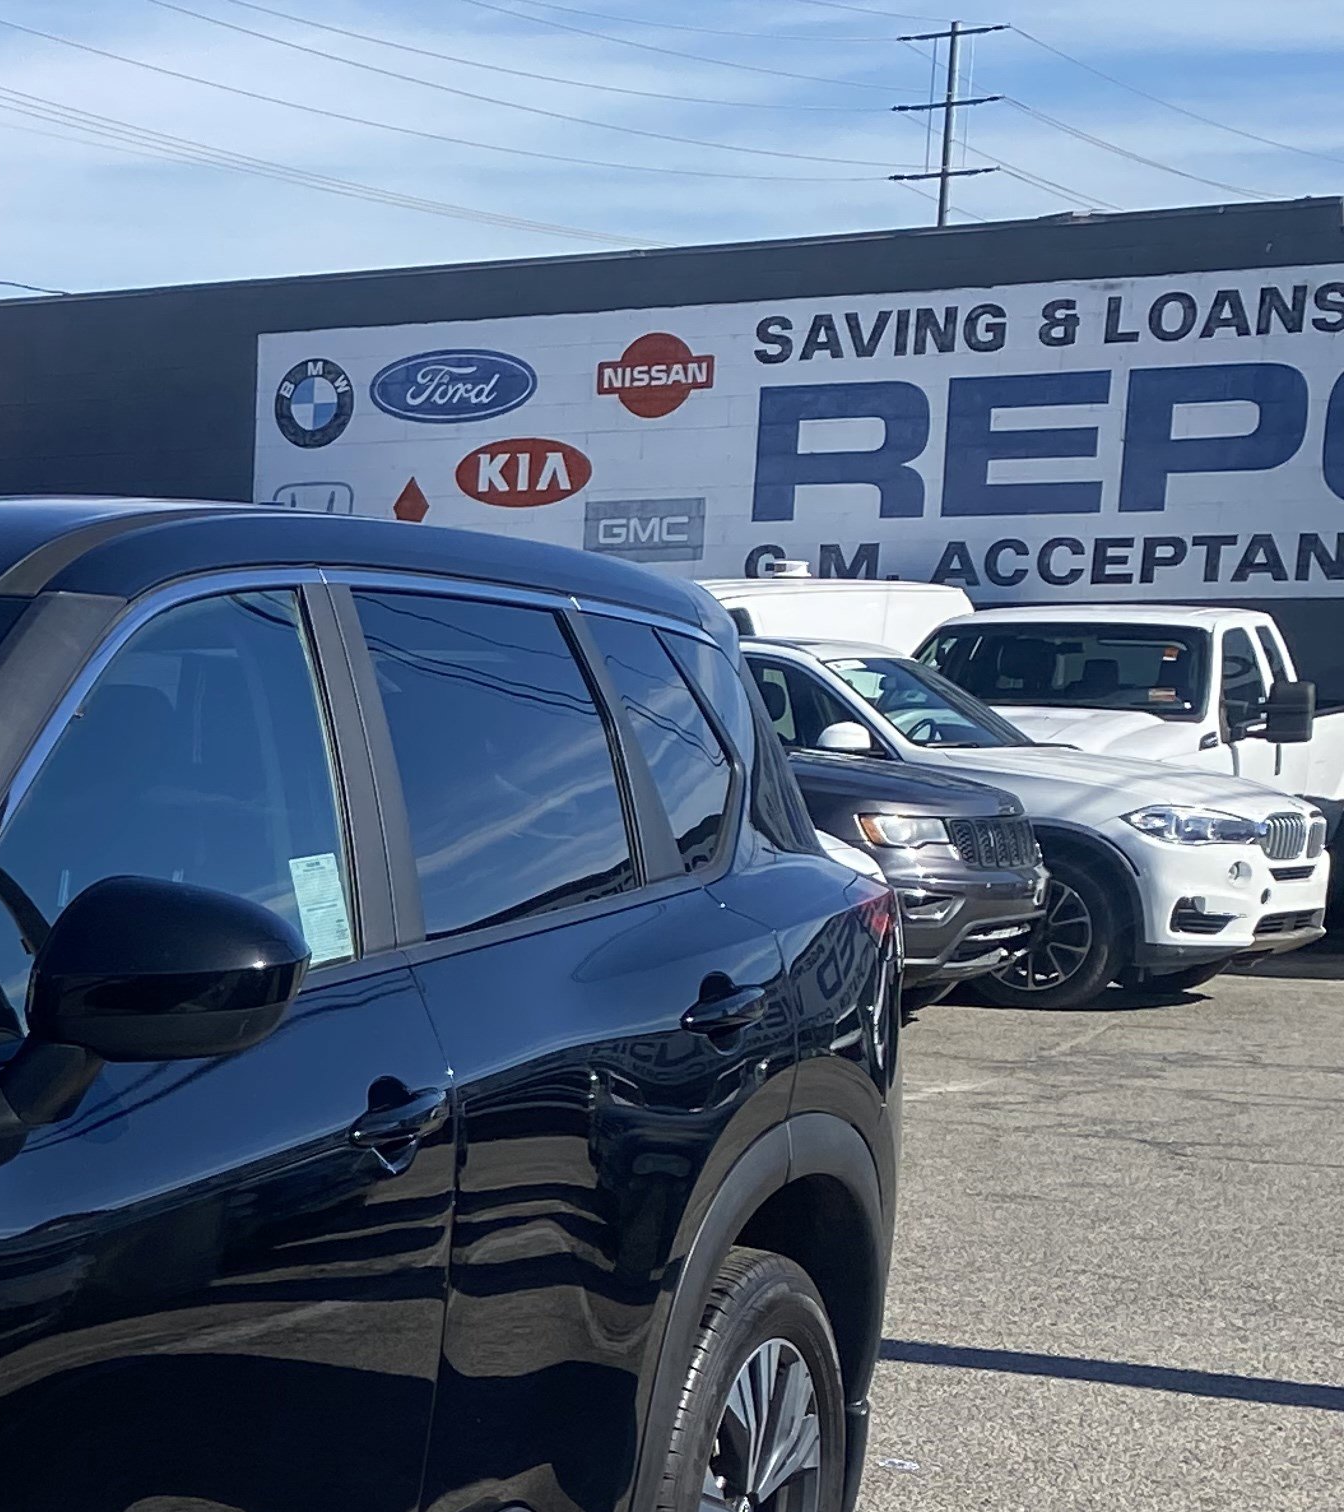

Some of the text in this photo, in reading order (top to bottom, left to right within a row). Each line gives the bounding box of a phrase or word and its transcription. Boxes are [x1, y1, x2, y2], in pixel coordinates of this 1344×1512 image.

[754, 282, 1344, 364] SAVING & LOANS
[280, 360, 352, 399] BMW
[406, 364, 499, 406] Ford
[603, 361, 709, 388] NISSAN
[751, 362, 1344, 522] REP
[477, 452, 573, 493] KIA
[598, 516, 689, 544] GMC
[929, 532, 1344, 587] ACCEPTAN
